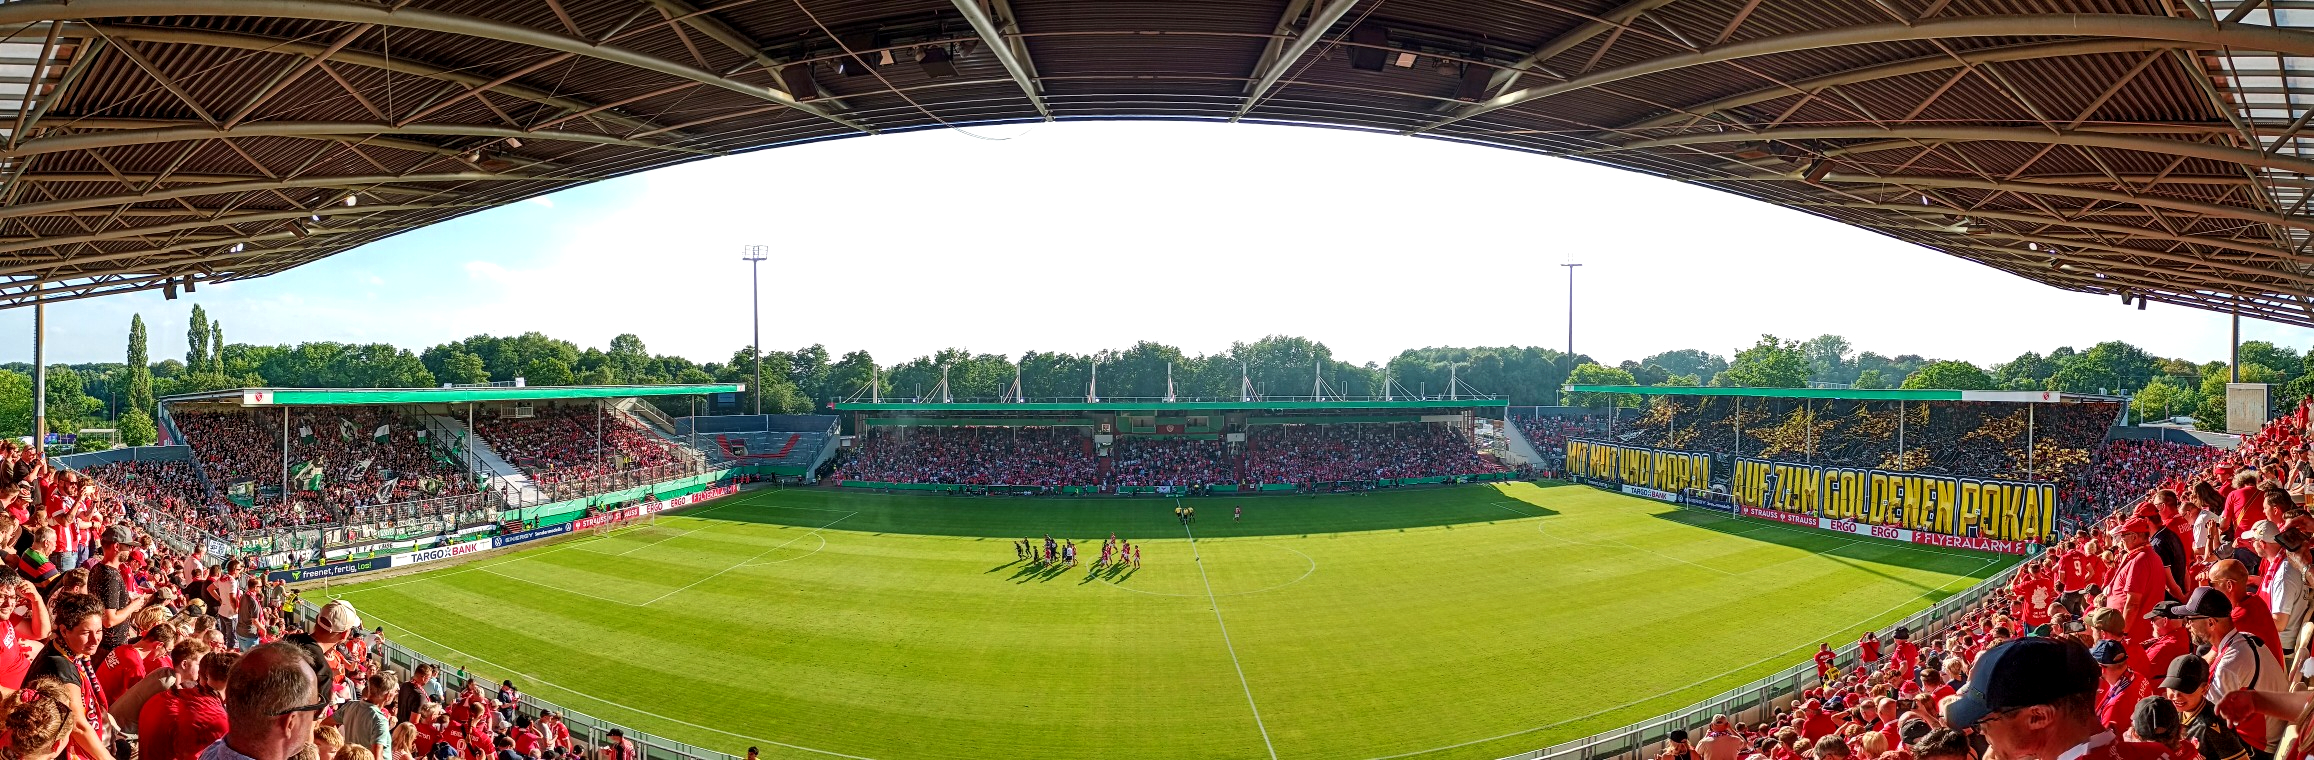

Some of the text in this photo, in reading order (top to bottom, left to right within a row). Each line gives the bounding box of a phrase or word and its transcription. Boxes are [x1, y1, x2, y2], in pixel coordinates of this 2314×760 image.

[1566, 439, 1710, 493] MIT MUT UND MORAL
[646, 502, 663, 514] ERGO
[671, 497, 686, 508] ERGO
[1732, 459, 2057, 544] AUF ZUM GOLDENEN POKAL
[1750, 508, 1778, 519] STRAUSS
[1787, 514, 1817, 525] STRAUSS
[1830, 520, 1857, 533] ERGO
[1871, 525, 1899, 539] ERGO
[1925, 533, 2012, 553] FLYERALARM
[303, 567, 334, 579] freenet,
[334, 564, 357, 574] fertig,
[2073, 560, 2082, 577] 9
